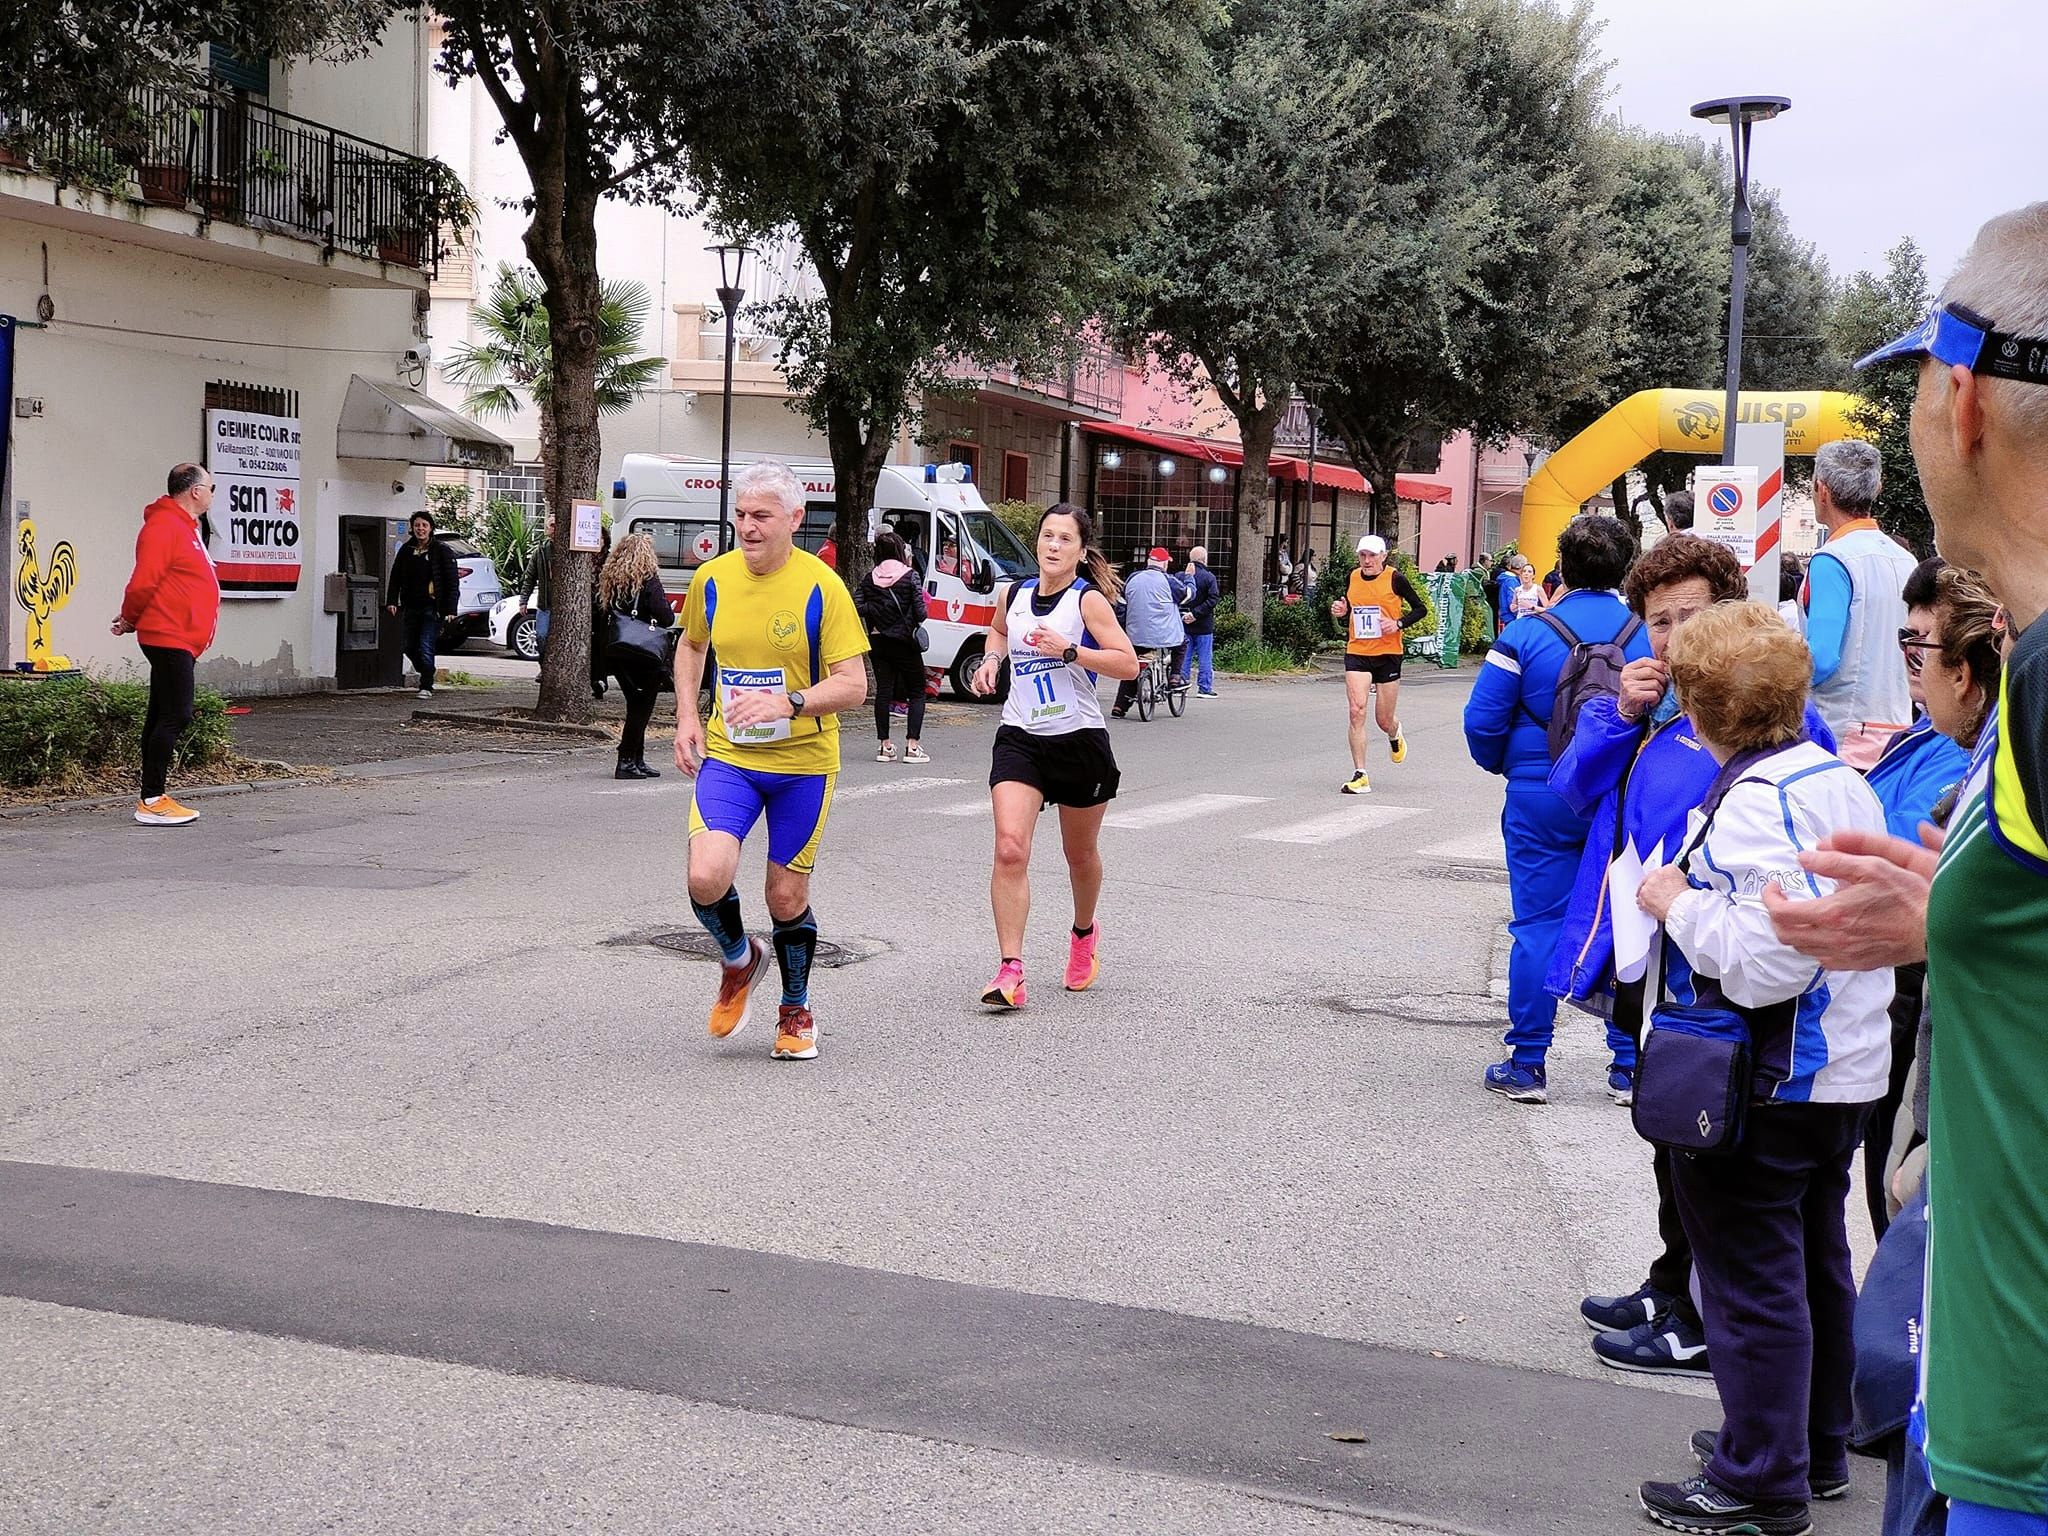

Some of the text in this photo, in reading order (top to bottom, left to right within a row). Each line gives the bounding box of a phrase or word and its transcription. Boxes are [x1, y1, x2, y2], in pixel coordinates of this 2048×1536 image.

[229, 484, 268, 513] san
[230, 517, 299, 547] marco
[1361, 615, 1372, 630] 14
[1032, 672, 1056, 705] 11
